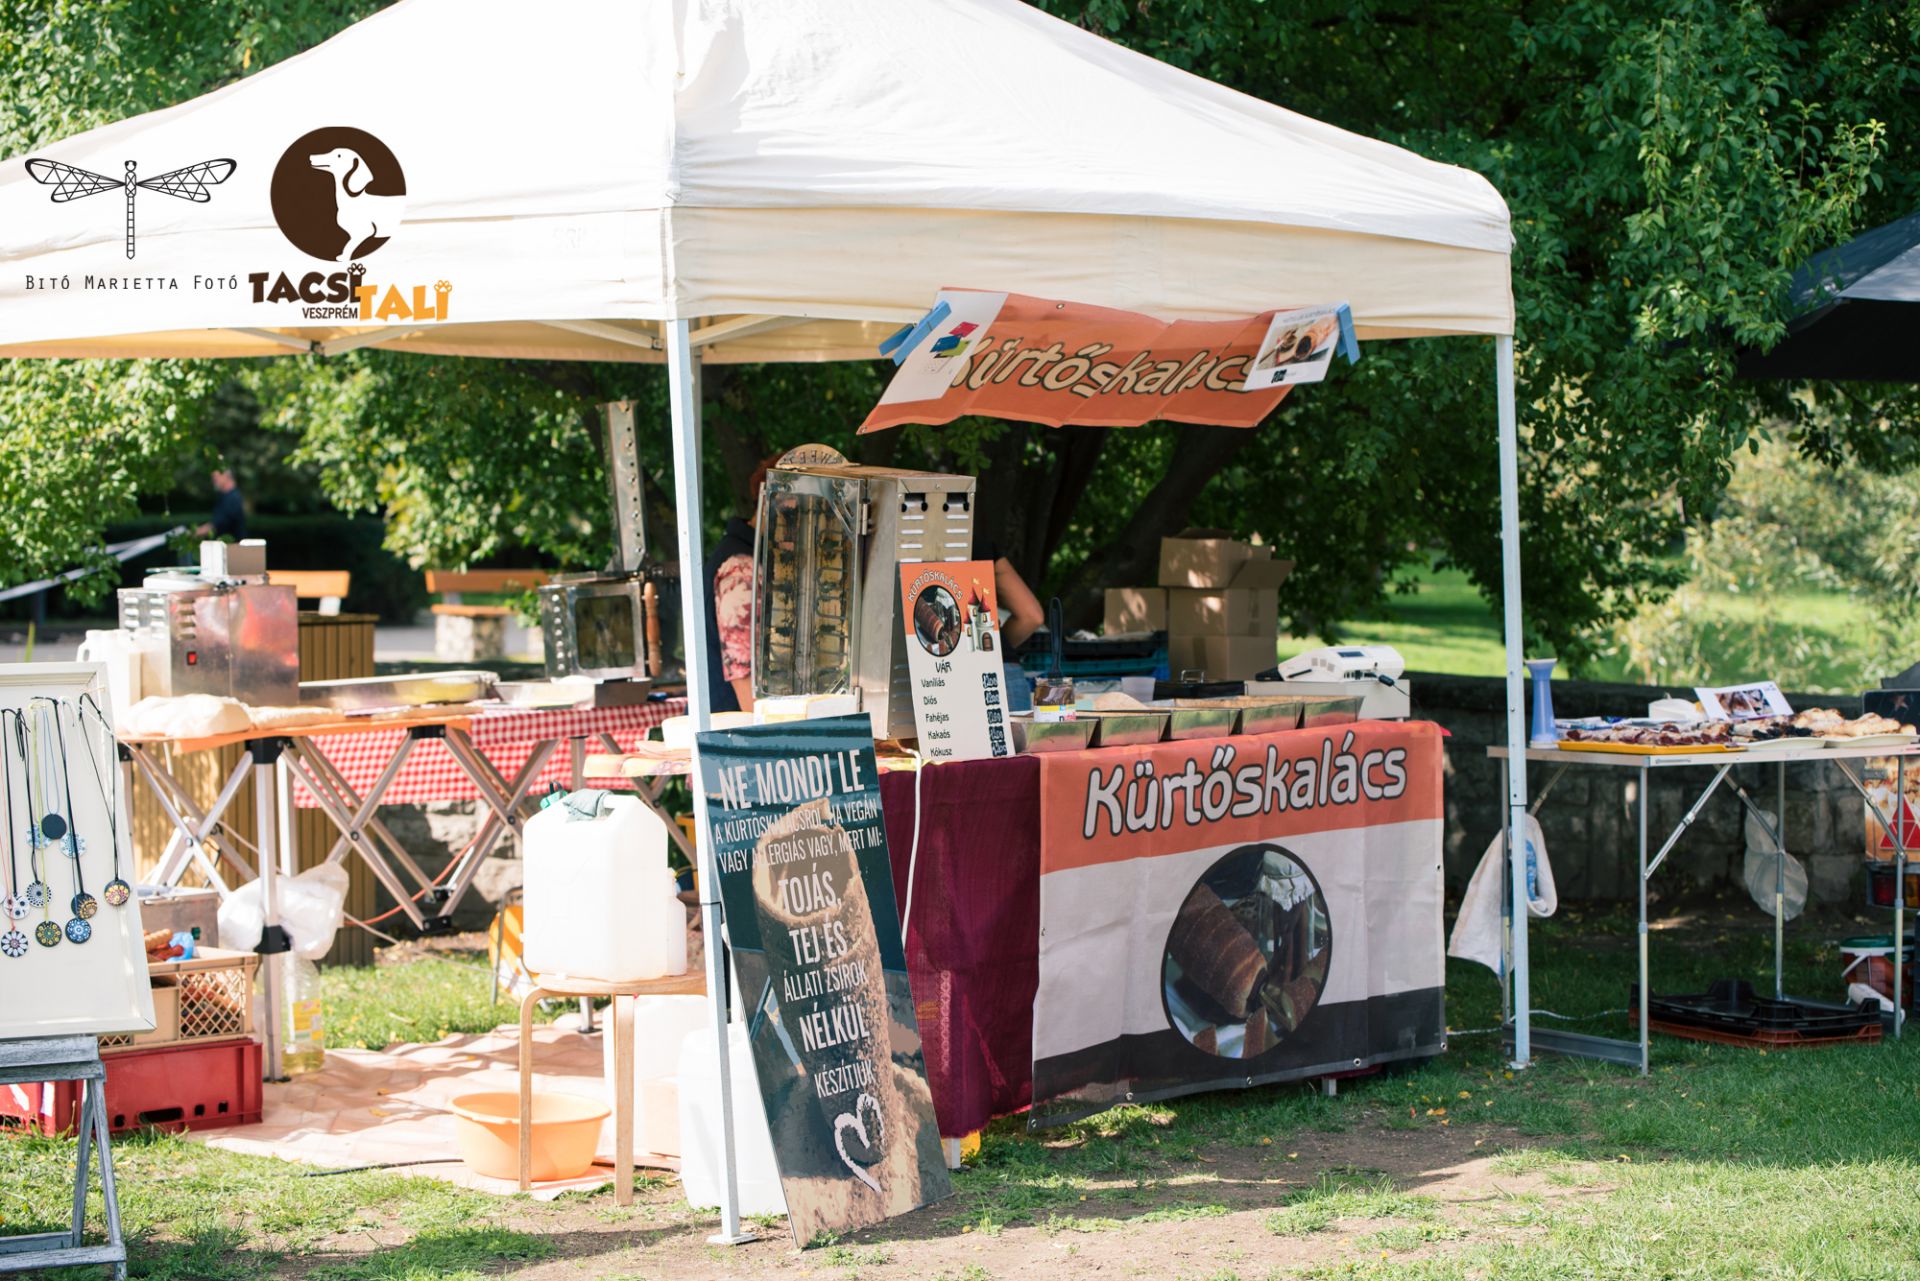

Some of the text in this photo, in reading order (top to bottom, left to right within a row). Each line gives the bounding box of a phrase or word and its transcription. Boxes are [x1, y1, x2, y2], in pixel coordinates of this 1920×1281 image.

[718, 749, 865, 811] NE MONDJ LE
[1082, 730, 1409, 840] Kürtőskalács
[715, 824, 723, 845] A
[830, 807, 843, 826] HA
[844, 794, 878, 822] VEGÁN
[719, 826, 883, 874] VAGY ALERGIÁS VAGY, MERT MI:
[778, 862, 842, 914] TOJÁS,
[789, 913, 849, 966] TEJ ÉS
[784, 958, 869, 1003] ÁLLATI ZSÍROK
[799, 996, 870, 1052] NÉLKÜL
[814, 1054, 875, 1099] KÉSZÍTJÜK
